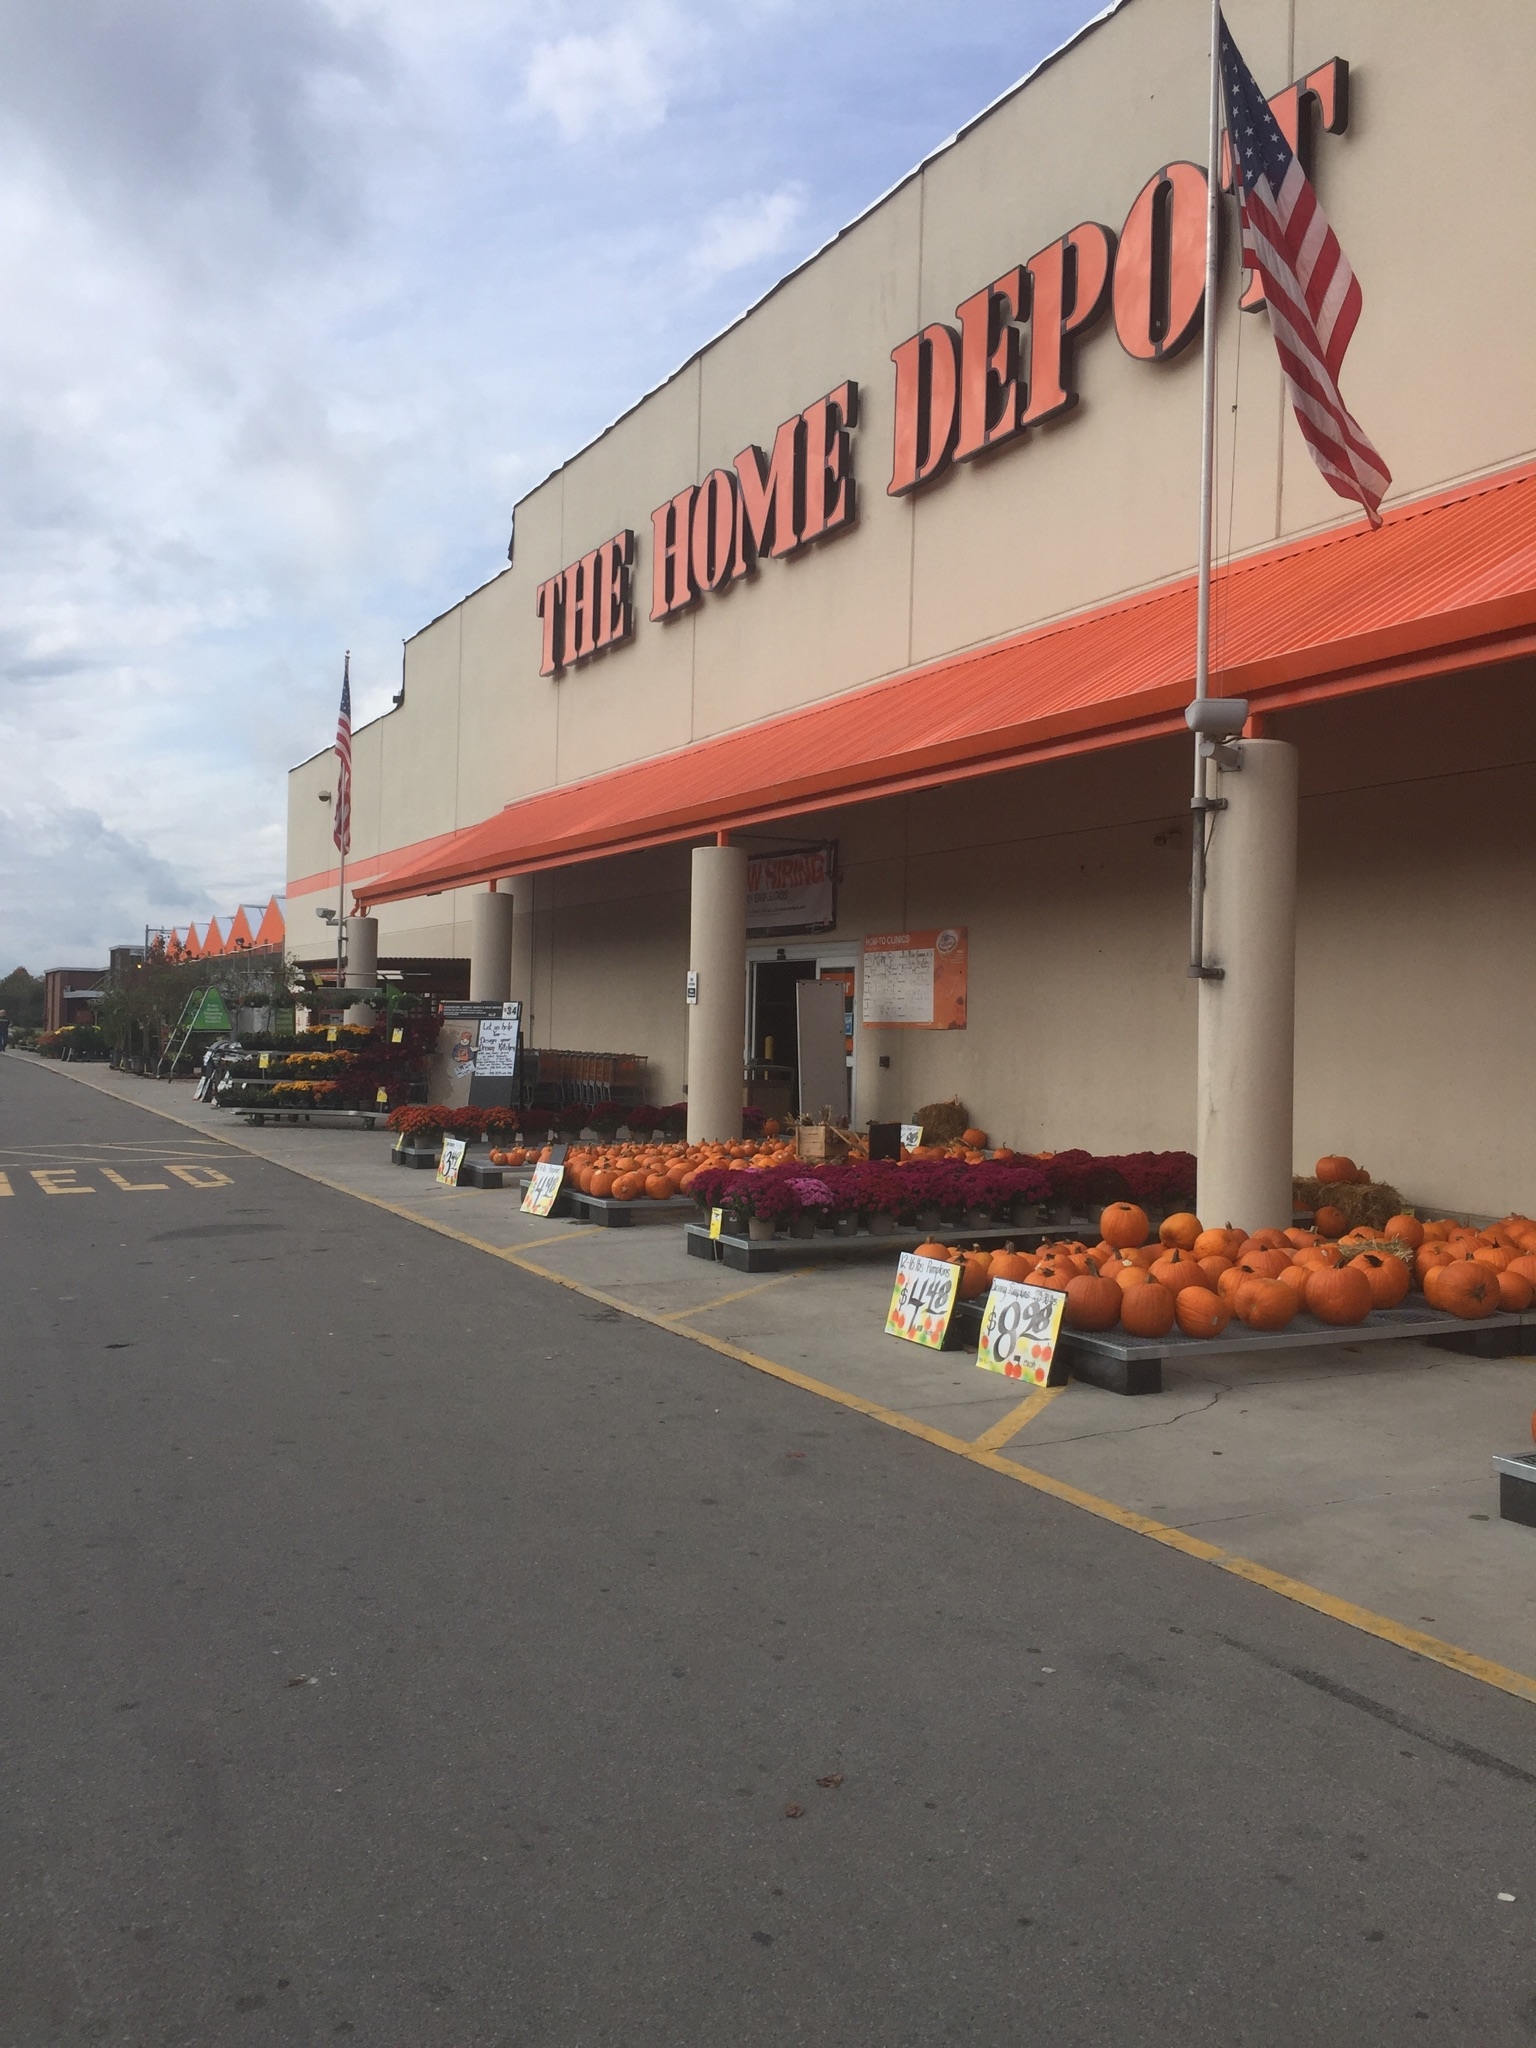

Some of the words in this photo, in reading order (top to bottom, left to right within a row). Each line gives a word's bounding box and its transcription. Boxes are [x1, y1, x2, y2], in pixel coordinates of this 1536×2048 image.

[537, 529, 634, 677] THE
[650, 380, 858, 624] HOME
[765, 854, 824, 889] HIRING
[886, 934, 910, 945] CLINICS
[926, 1259, 951, 1283] Pumpkins
